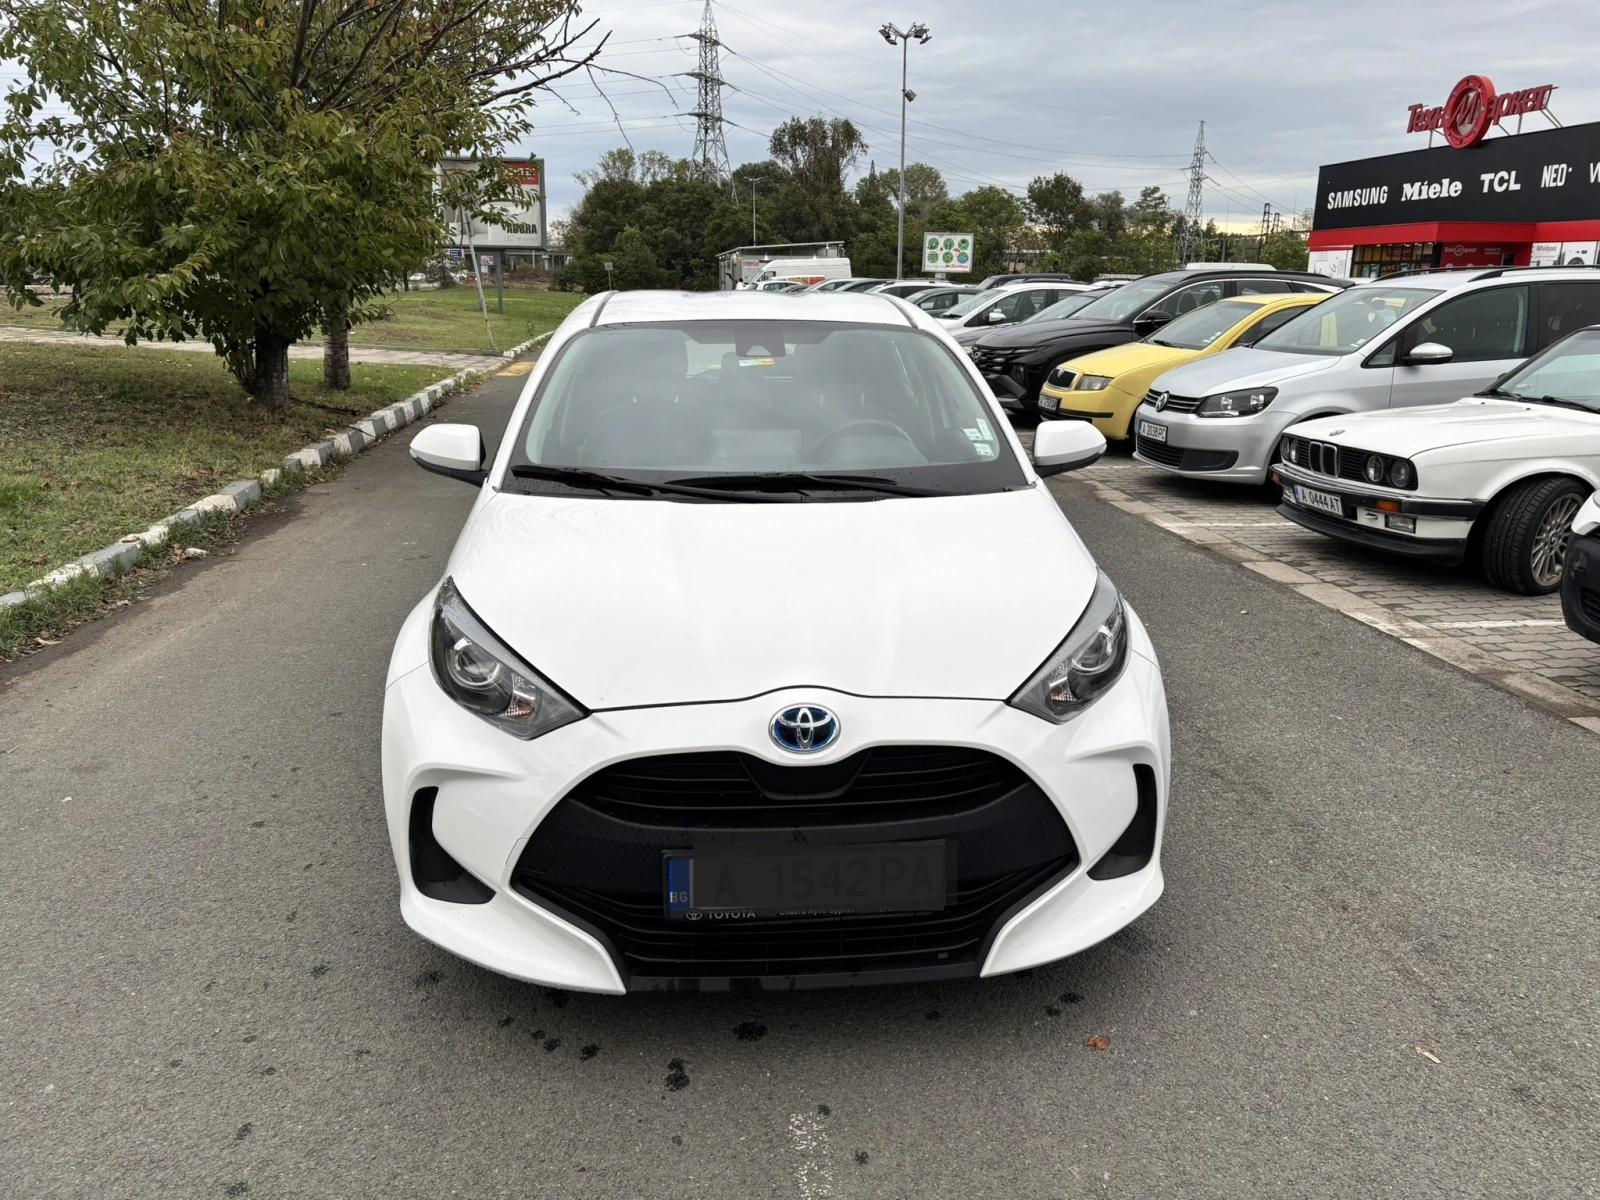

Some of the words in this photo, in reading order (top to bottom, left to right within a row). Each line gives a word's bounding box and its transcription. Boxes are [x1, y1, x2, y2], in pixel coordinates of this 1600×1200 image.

[1327, 185, 1388, 210] SAMSUNG
[1401, 178, 1462, 202] Miele
[1481, 171, 1521, 193] TCL
[669, 891, 688, 903] BG
[707, 908, 757, 920] TOYOTA
